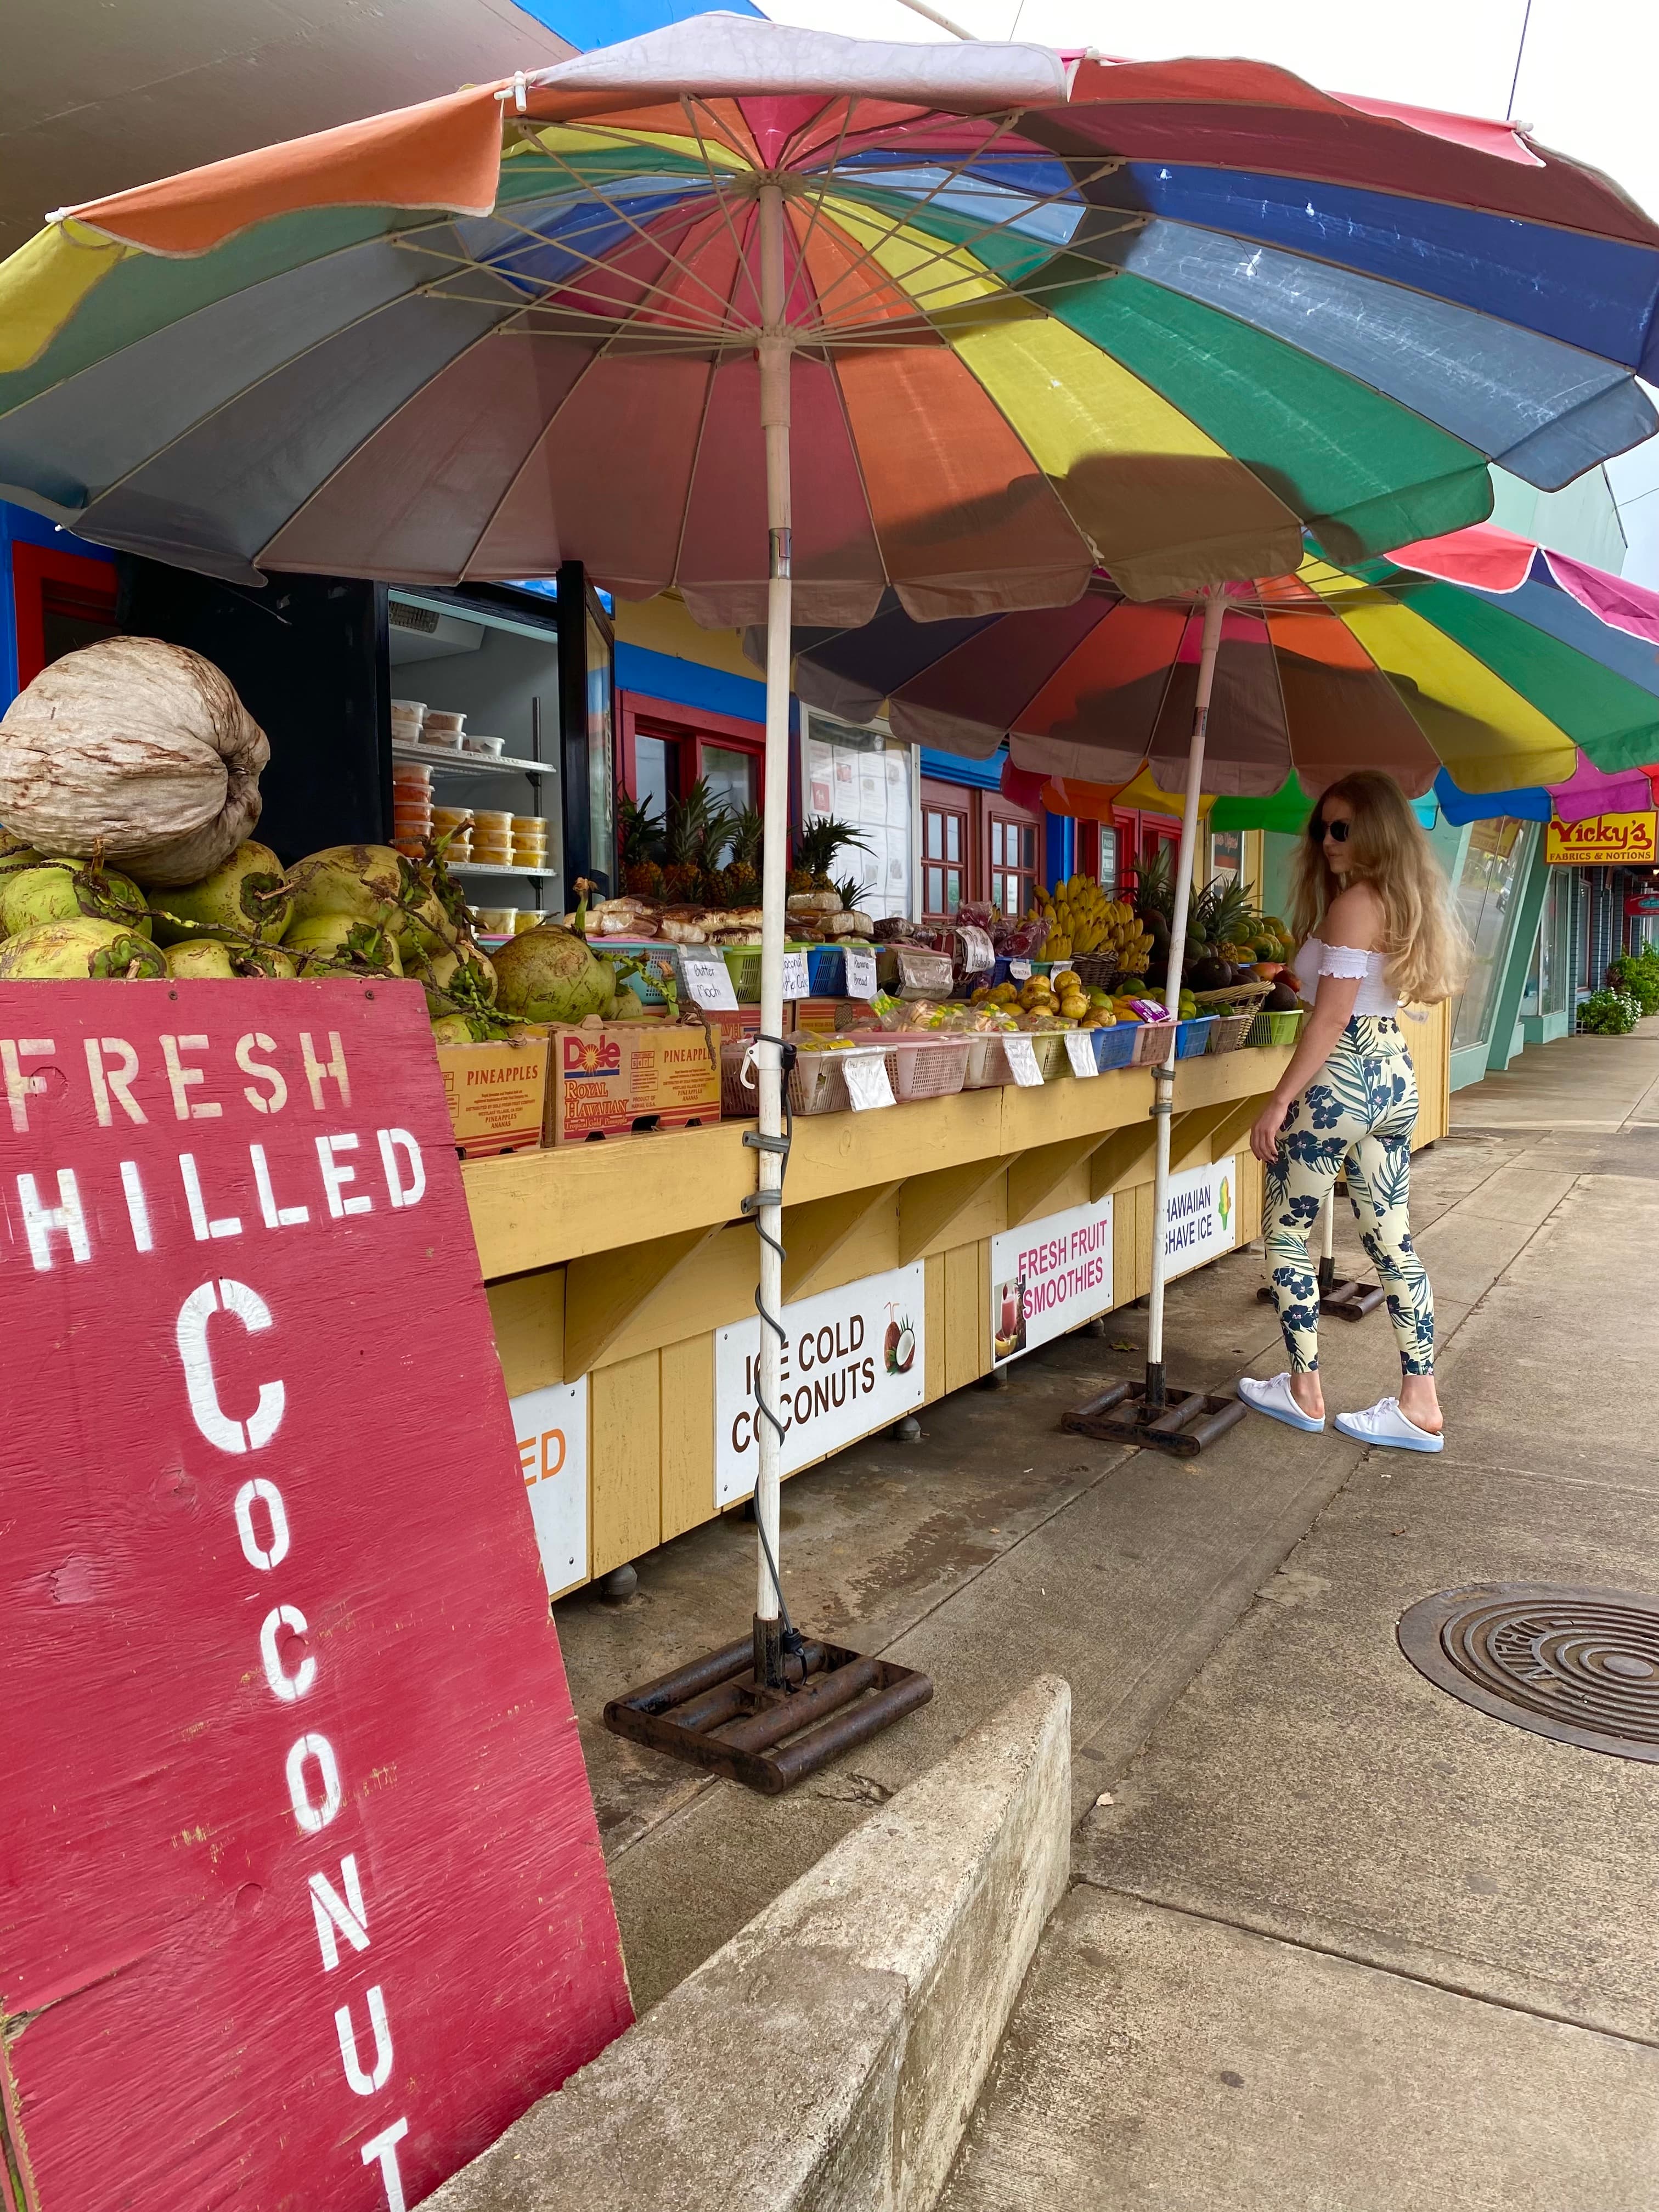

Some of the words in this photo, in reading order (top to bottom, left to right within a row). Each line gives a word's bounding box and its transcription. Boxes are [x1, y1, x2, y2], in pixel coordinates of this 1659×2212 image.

[1550, 816, 1652, 851] Vicky's
[1606, 851, 1651, 860] NOTIONS
[694, 964, 714, 977] Butter
[783, 953, 802, 969] oconut
[697, 984, 721, 997] Mochi
[563, 1035, 620, 1071] Dole
[664, 1047, 715, 1063] PINEAPPLE
[1, 1032, 352, 1132] FRESH
[467, 1065, 538, 1085] PINEAPPLES
[564, 1080, 608, 1099] ROYAL
[486, 1113, 517, 1123] PINEAPPLES
[564, 1098, 629, 1120] HAWAIIAN
[16, 1128, 426, 1271] HILLED
[1198, 1214, 1212, 1241] ICE
[1018, 1237, 1066, 1281] FRESH
[1071, 1220, 1107, 1260] FRUIT
[1023, 1257, 1103, 1319] SMOOTHIES
[799, 1314, 864, 1372] COLD
